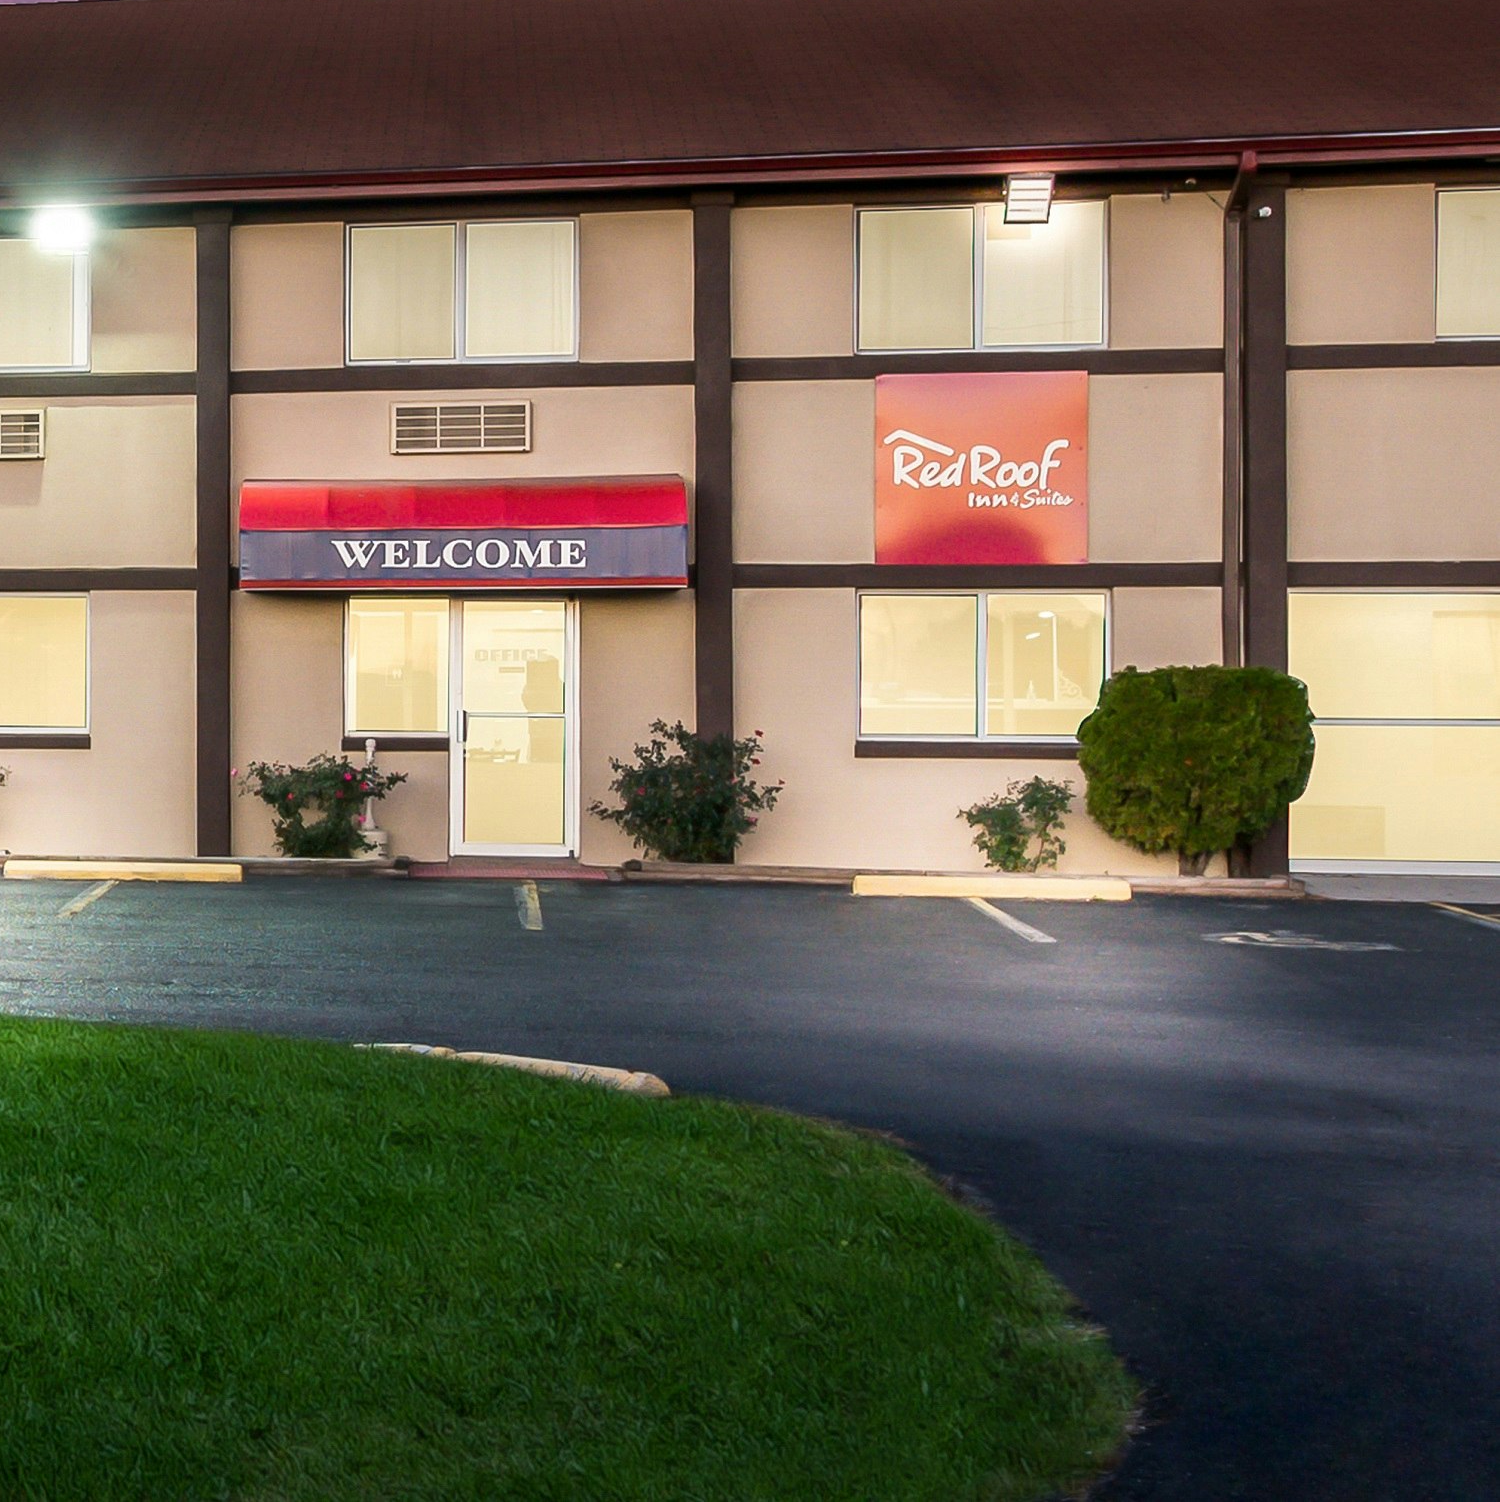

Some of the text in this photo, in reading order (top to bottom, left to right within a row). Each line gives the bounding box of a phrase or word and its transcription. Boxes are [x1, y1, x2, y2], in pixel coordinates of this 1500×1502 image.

[968, 488, 1073, 509] Inn & Suites
[331, 539, 587, 569] WELCOME
